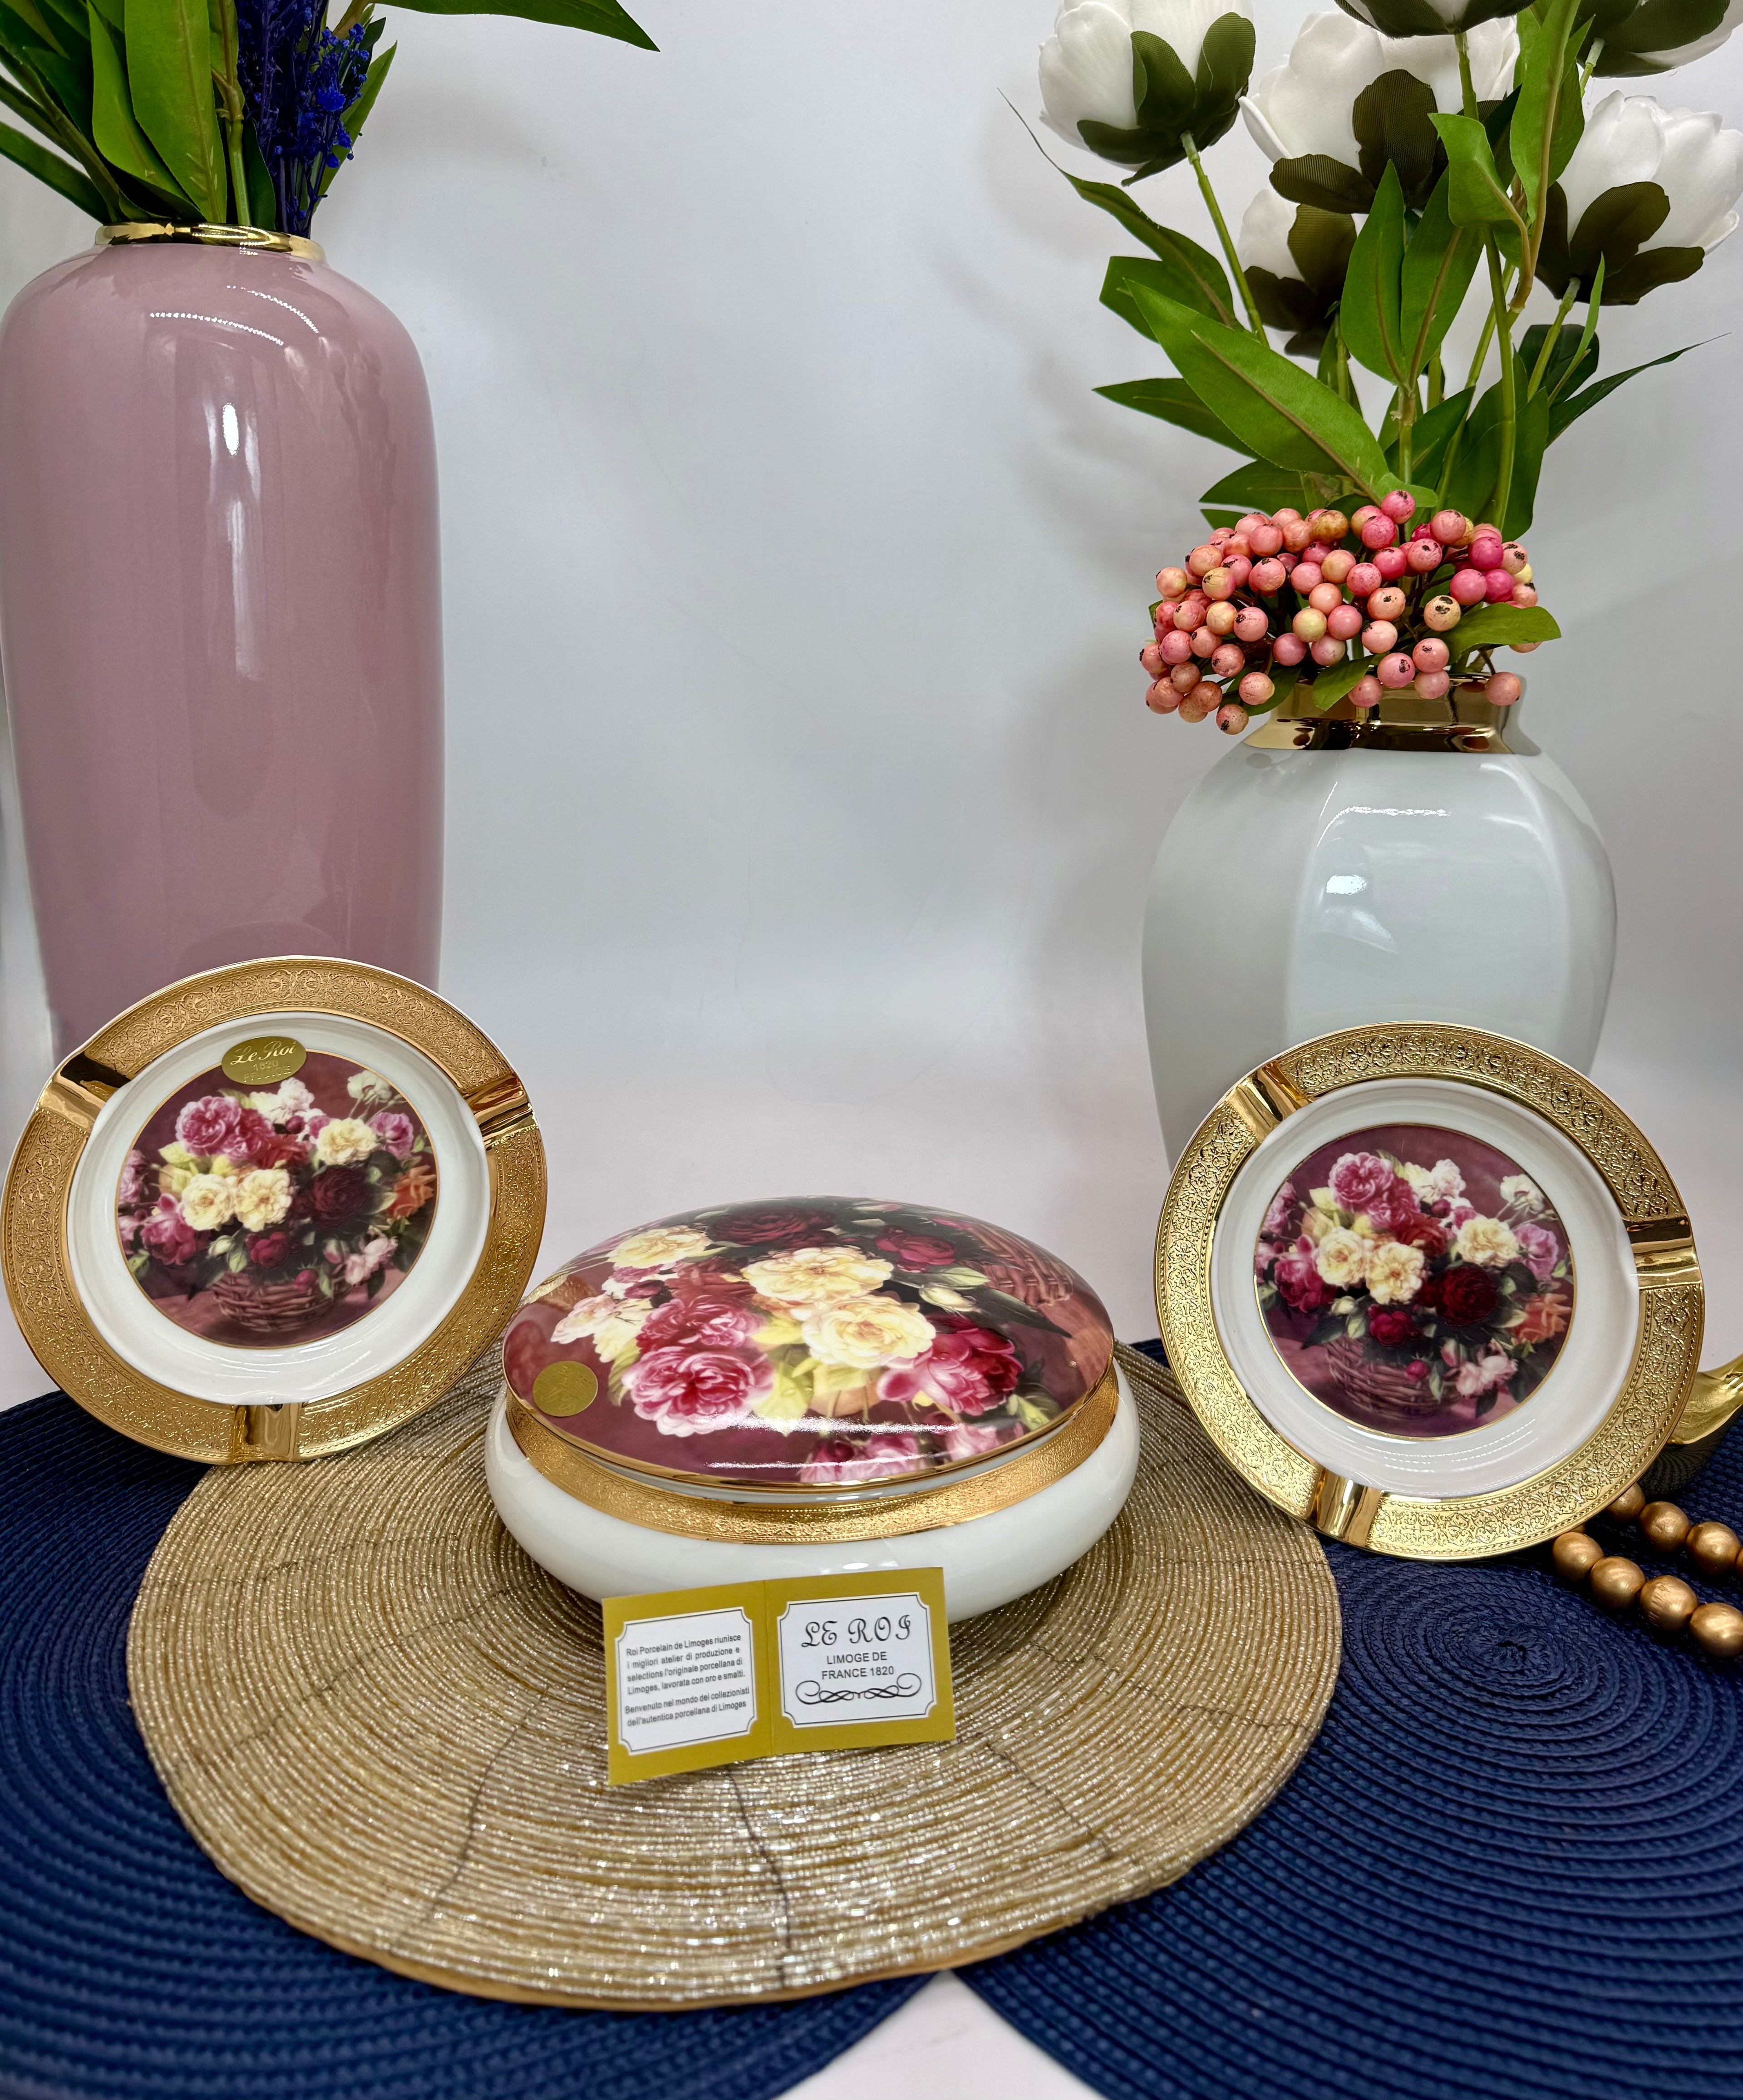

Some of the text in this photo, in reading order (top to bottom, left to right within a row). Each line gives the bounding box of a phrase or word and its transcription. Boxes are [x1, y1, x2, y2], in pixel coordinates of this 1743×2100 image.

[230, 1040, 296, 1065] Le Roi
[253, 1060, 278, 1071] 1820
[801, 1614, 911, 1647] LE ROI
[626, 1647, 638, 1656] Roi
[640, 1643, 673, 1654] Porcelain
[684, 1639, 713, 1648] Limoges
[714, 1634, 741, 1644] riunisce
[627, 1657, 743, 1682] selections l'originale porcellana di
[632, 1657, 659, 1669] migliori
[661, 1654, 683, 1664] atelier
[686, 1652, 692, 1661] di
[695, 1648, 733, 1661] produzione
[827, 1651, 887, 1665] LIMOGE DE
[628, 1684, 660, 1695] Limoges,
[662, 1679, 690, 1689] lavorata
[723, 1670, 745, 1680] smalti.
[822, 1666, 894, 1680] FRANCE 1820
[625, 1701, 662, 1714] Benvenuto
[664, 1699, 674, 1707] nel
[675, 1696, 698, 1706] mondo
[711, 1686, 750, 1700] collezionisti
[627, 1701, 747, 1726] dell'autentica porcellana di Limoges
